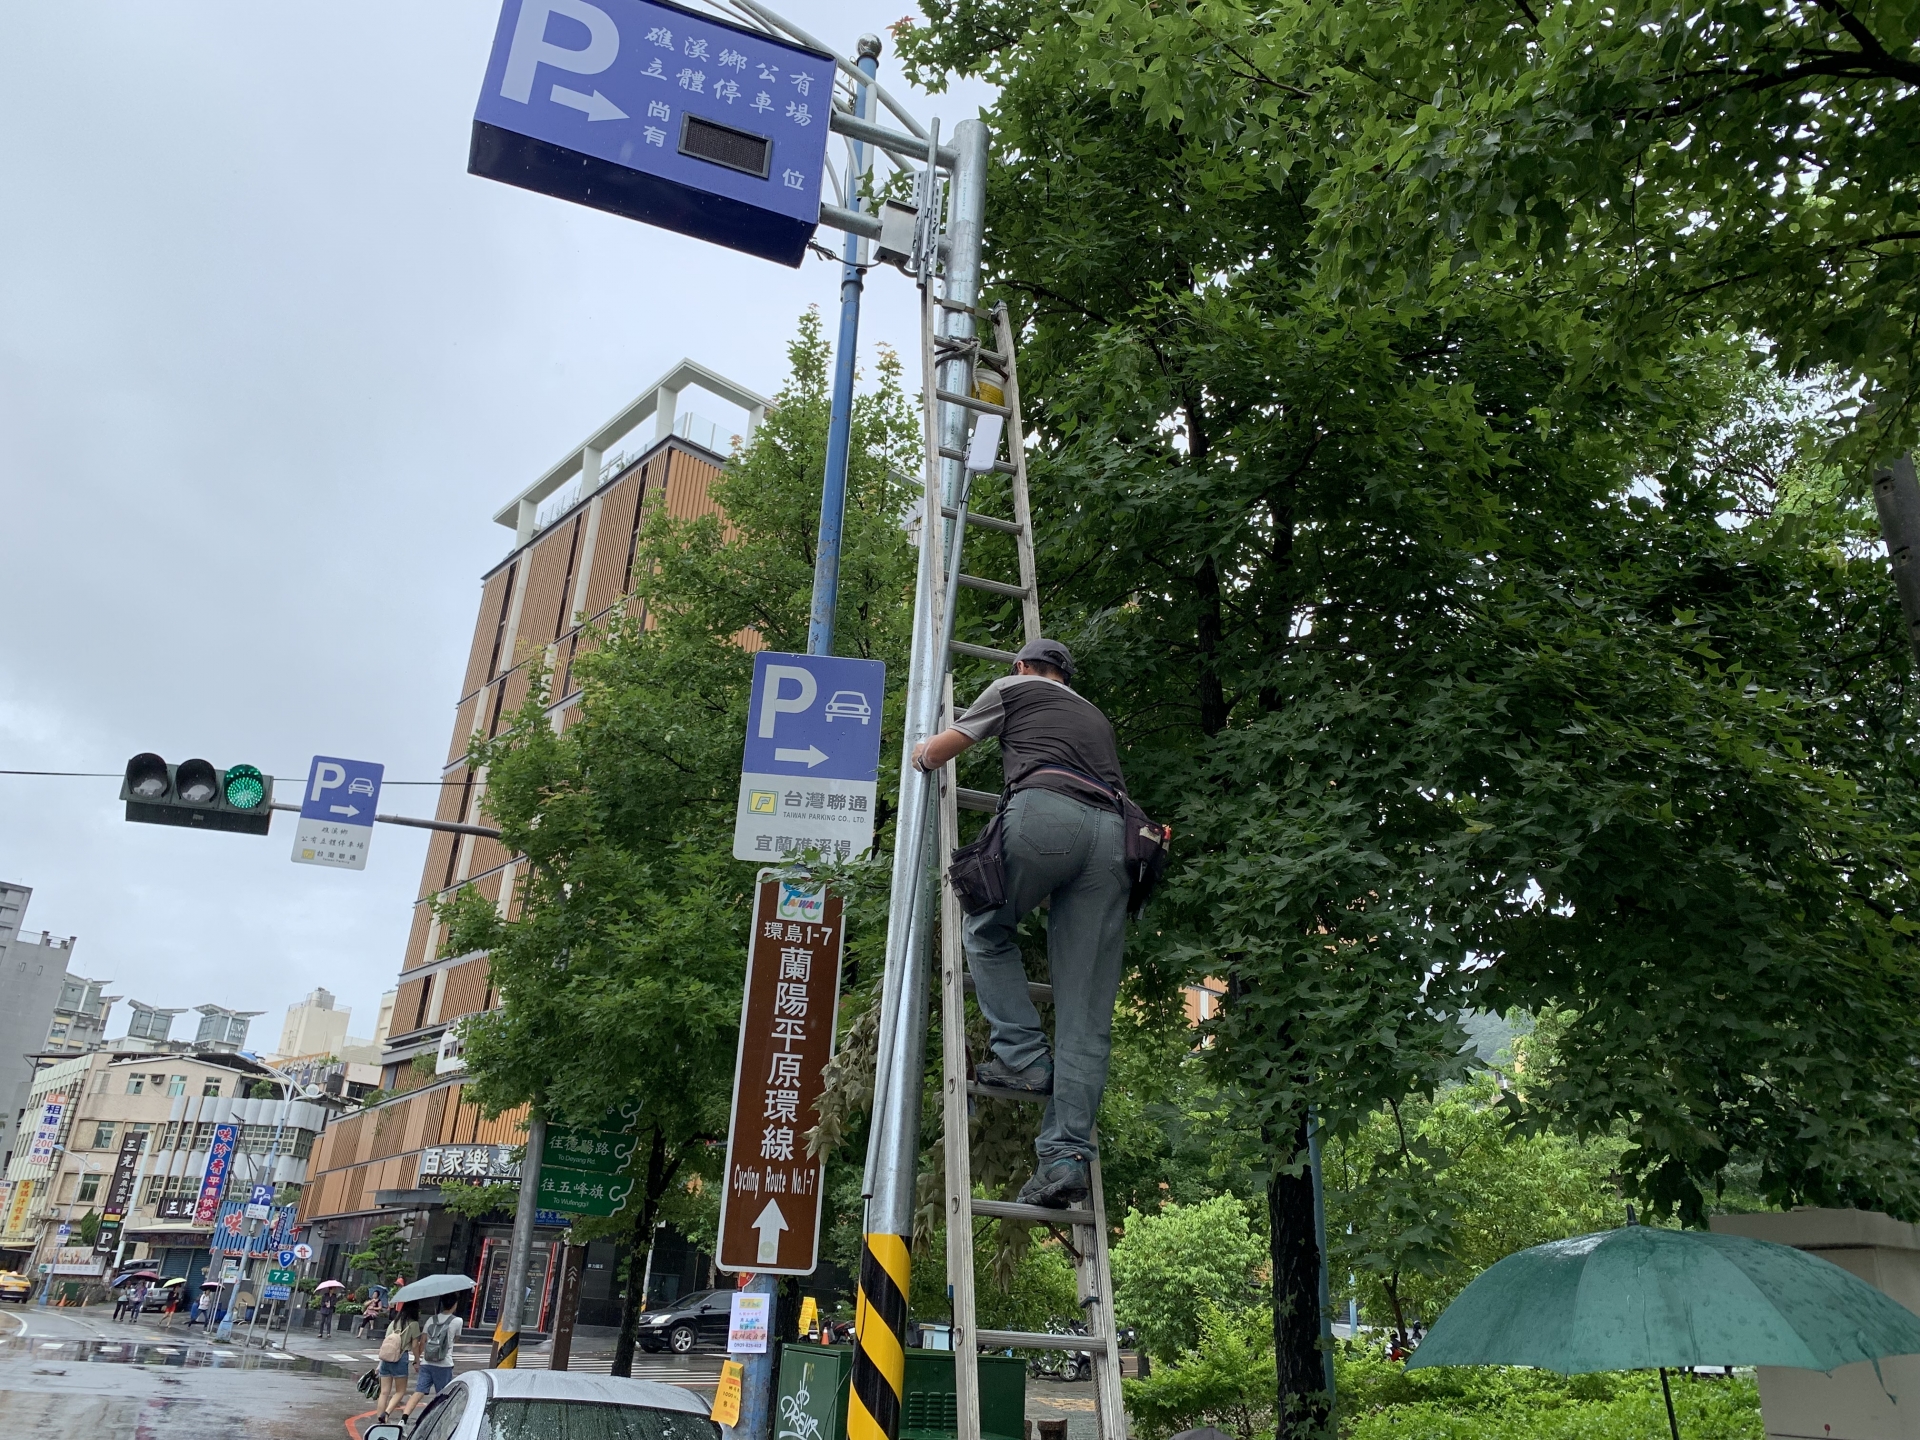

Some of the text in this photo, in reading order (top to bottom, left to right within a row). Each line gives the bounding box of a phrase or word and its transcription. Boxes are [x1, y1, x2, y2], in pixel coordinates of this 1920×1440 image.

[500, 0, 620, 104] P
[644, 26, 816, 97] 礁溪鄉公有
[640, 57, 813, 127] 立體停車場
[643, 99, 671, 148] 尚有
[782, 167, 805, 192] 位
[758, 664, 818, 739] P
[310, 761, 346, 802] P
[784, 790, 868, 812] 台灣聯通
[783, 811, 866, 824] TAIWAN PARKING CO., LTD.
[301, 835, 365, 850] 公有立體停車場
[763, 921, 833, 946] 環島1-7
[760, 946, 814, 1162] 蘭陽平原環線
[42, 1104, 62, 1125] 租車
[35, 1139, 53, 1148] 200
[31, 1154, 49, 1163] 300
[424, 1147, 490, 1176] 百家樂
[253, 1186, 266, 1199] P
[540, 1178, 604, 1199] 往五峰旗
[734, 1163, 815, 1200] Cycling Route No.1-7
[100, 1232, 112, 1244] P
[283, 1253, 291, 1262] 9
[273, 1272, 290, 1281] 72
